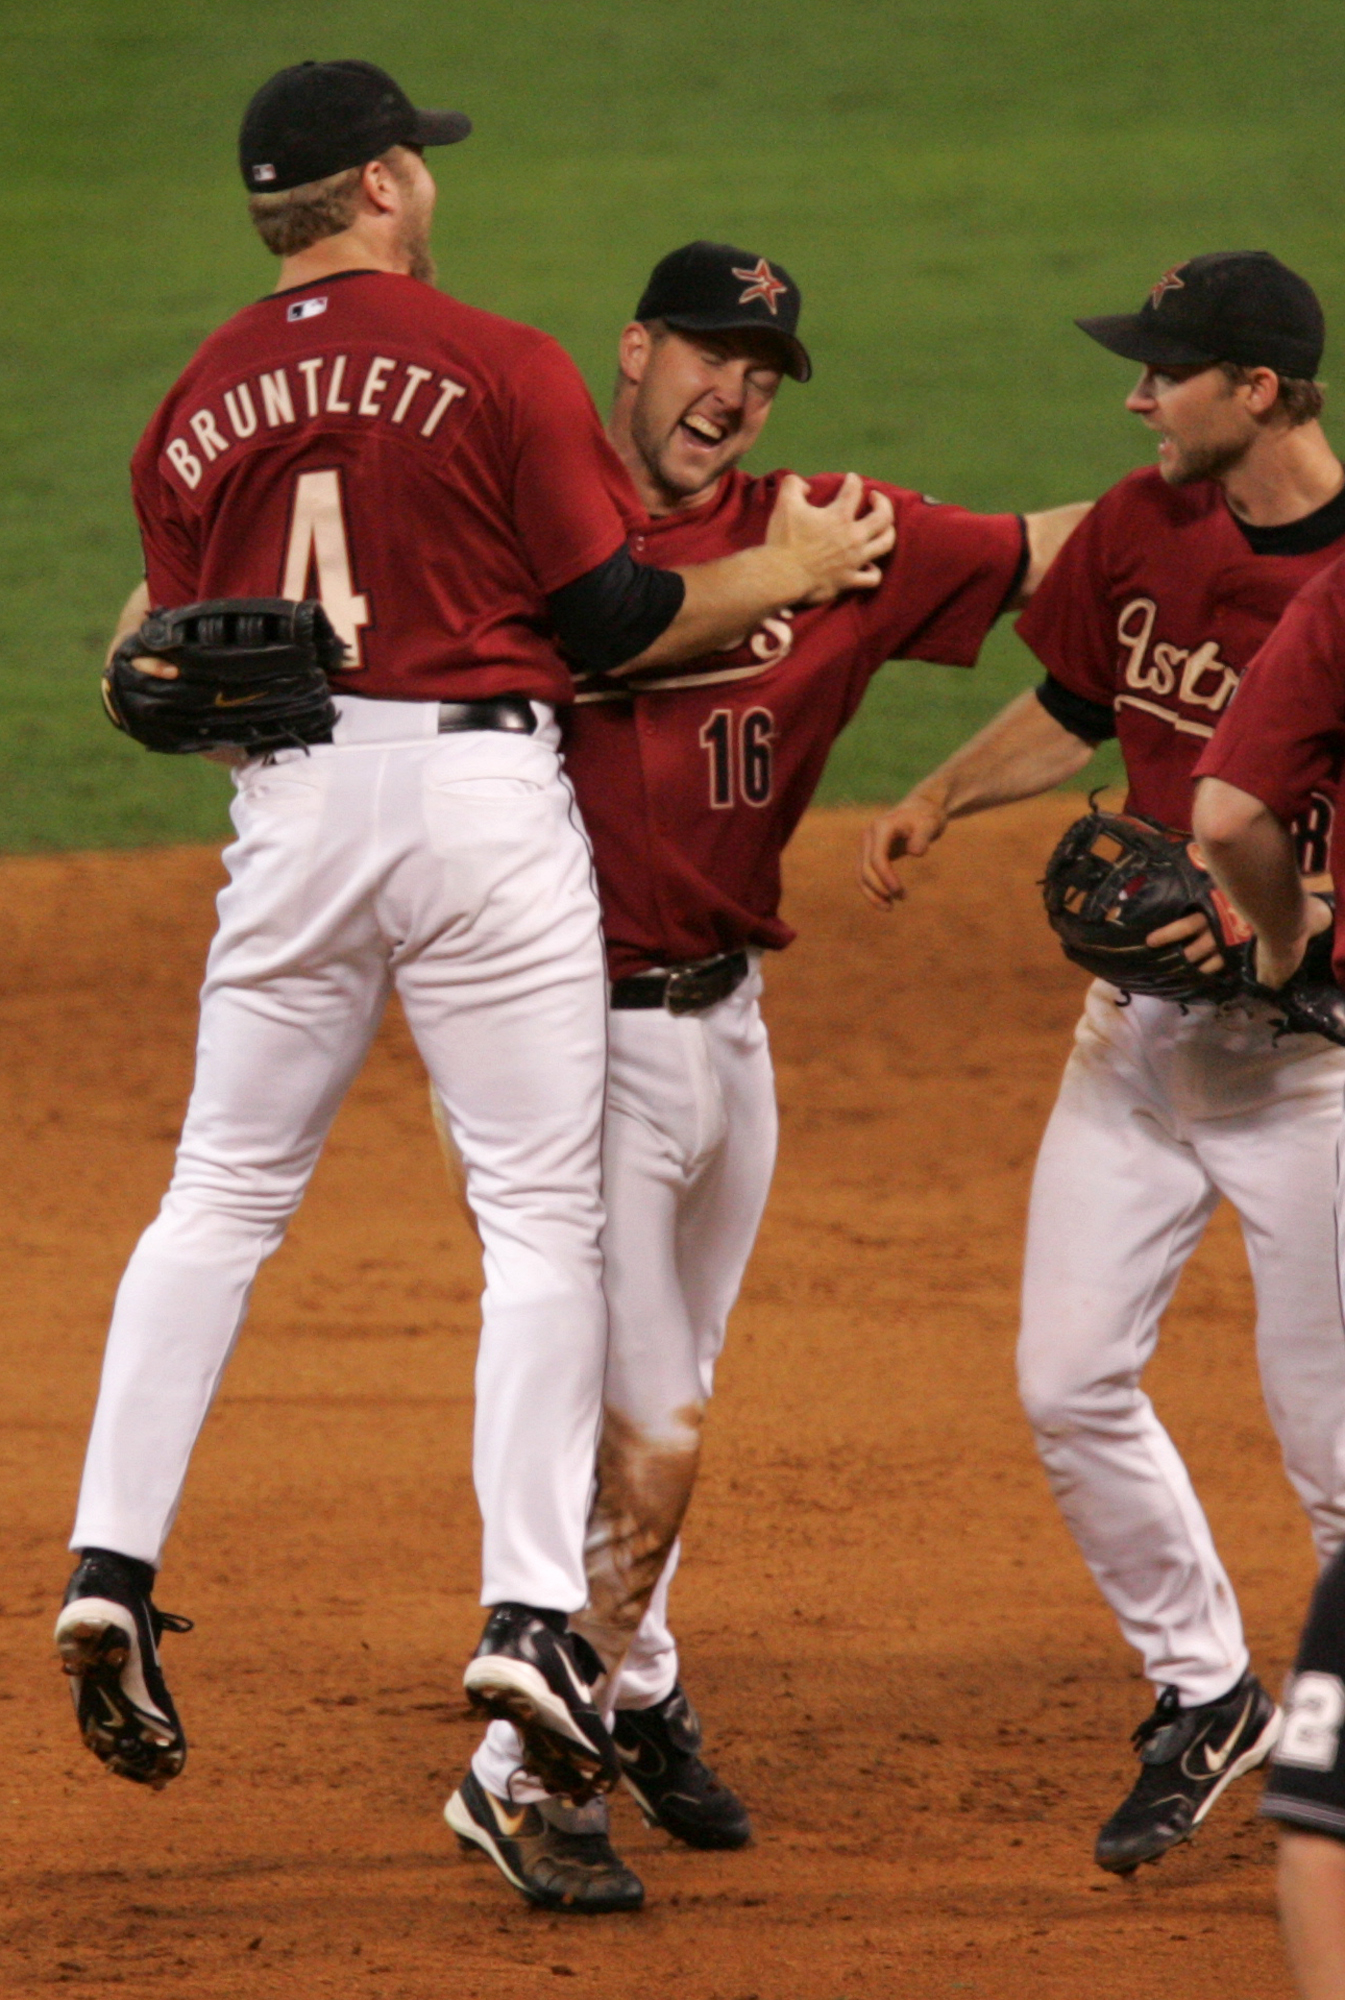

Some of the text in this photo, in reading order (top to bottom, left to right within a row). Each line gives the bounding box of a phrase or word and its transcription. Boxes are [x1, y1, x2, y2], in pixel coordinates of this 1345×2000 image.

[165, 354, 466, 490] BRUNTLETT
[281, 469, 369, 669] 4
[1117, 597, 1246, 711] Astr
[698, 705, 775, 810] 16
[1271, 1670, 1345, 1773] 2
